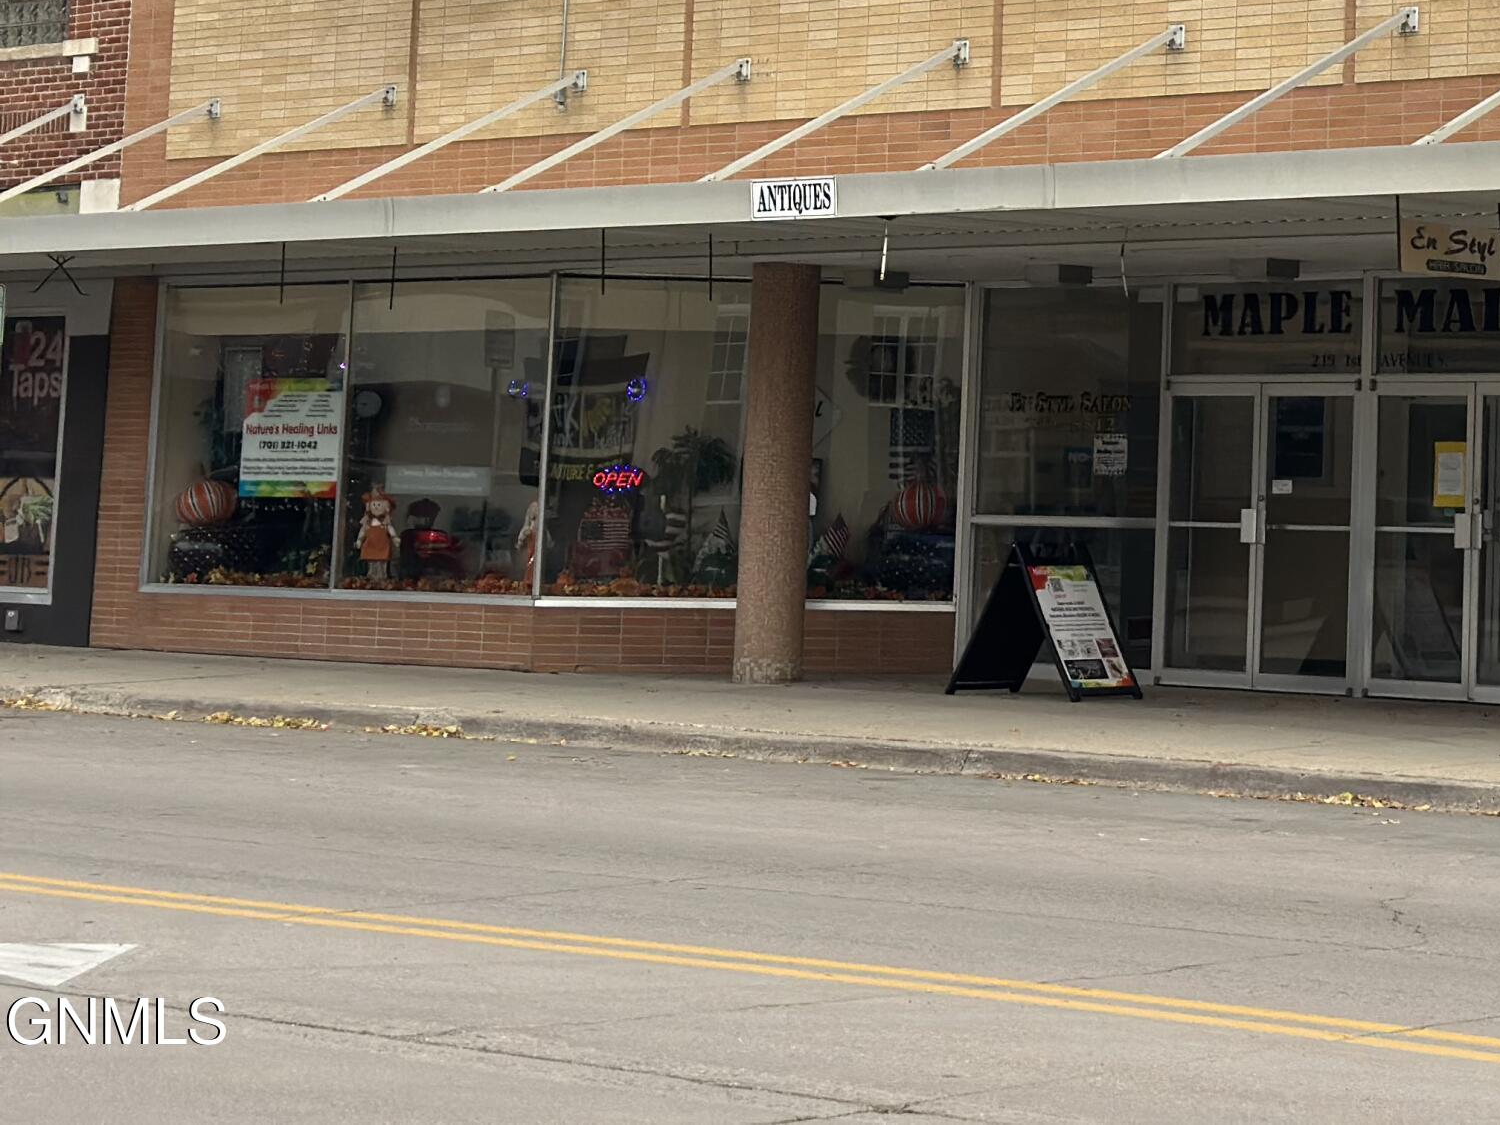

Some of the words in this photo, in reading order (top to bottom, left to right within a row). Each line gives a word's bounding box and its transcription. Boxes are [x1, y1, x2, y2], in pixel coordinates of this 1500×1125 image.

[757, 182, 831, 214] ANTIQUES
[1444, 229, 1496, 262] Styl
[1202, 290, 1354, 337] MAPLE
[27, 329, 63, 367] 24
[9, 363, 62, 408] Taps
[246, 423, 279, 435] Nature's
[282, 423, 315, 437] Healing
[593, 472, 644, 487] OPEN
